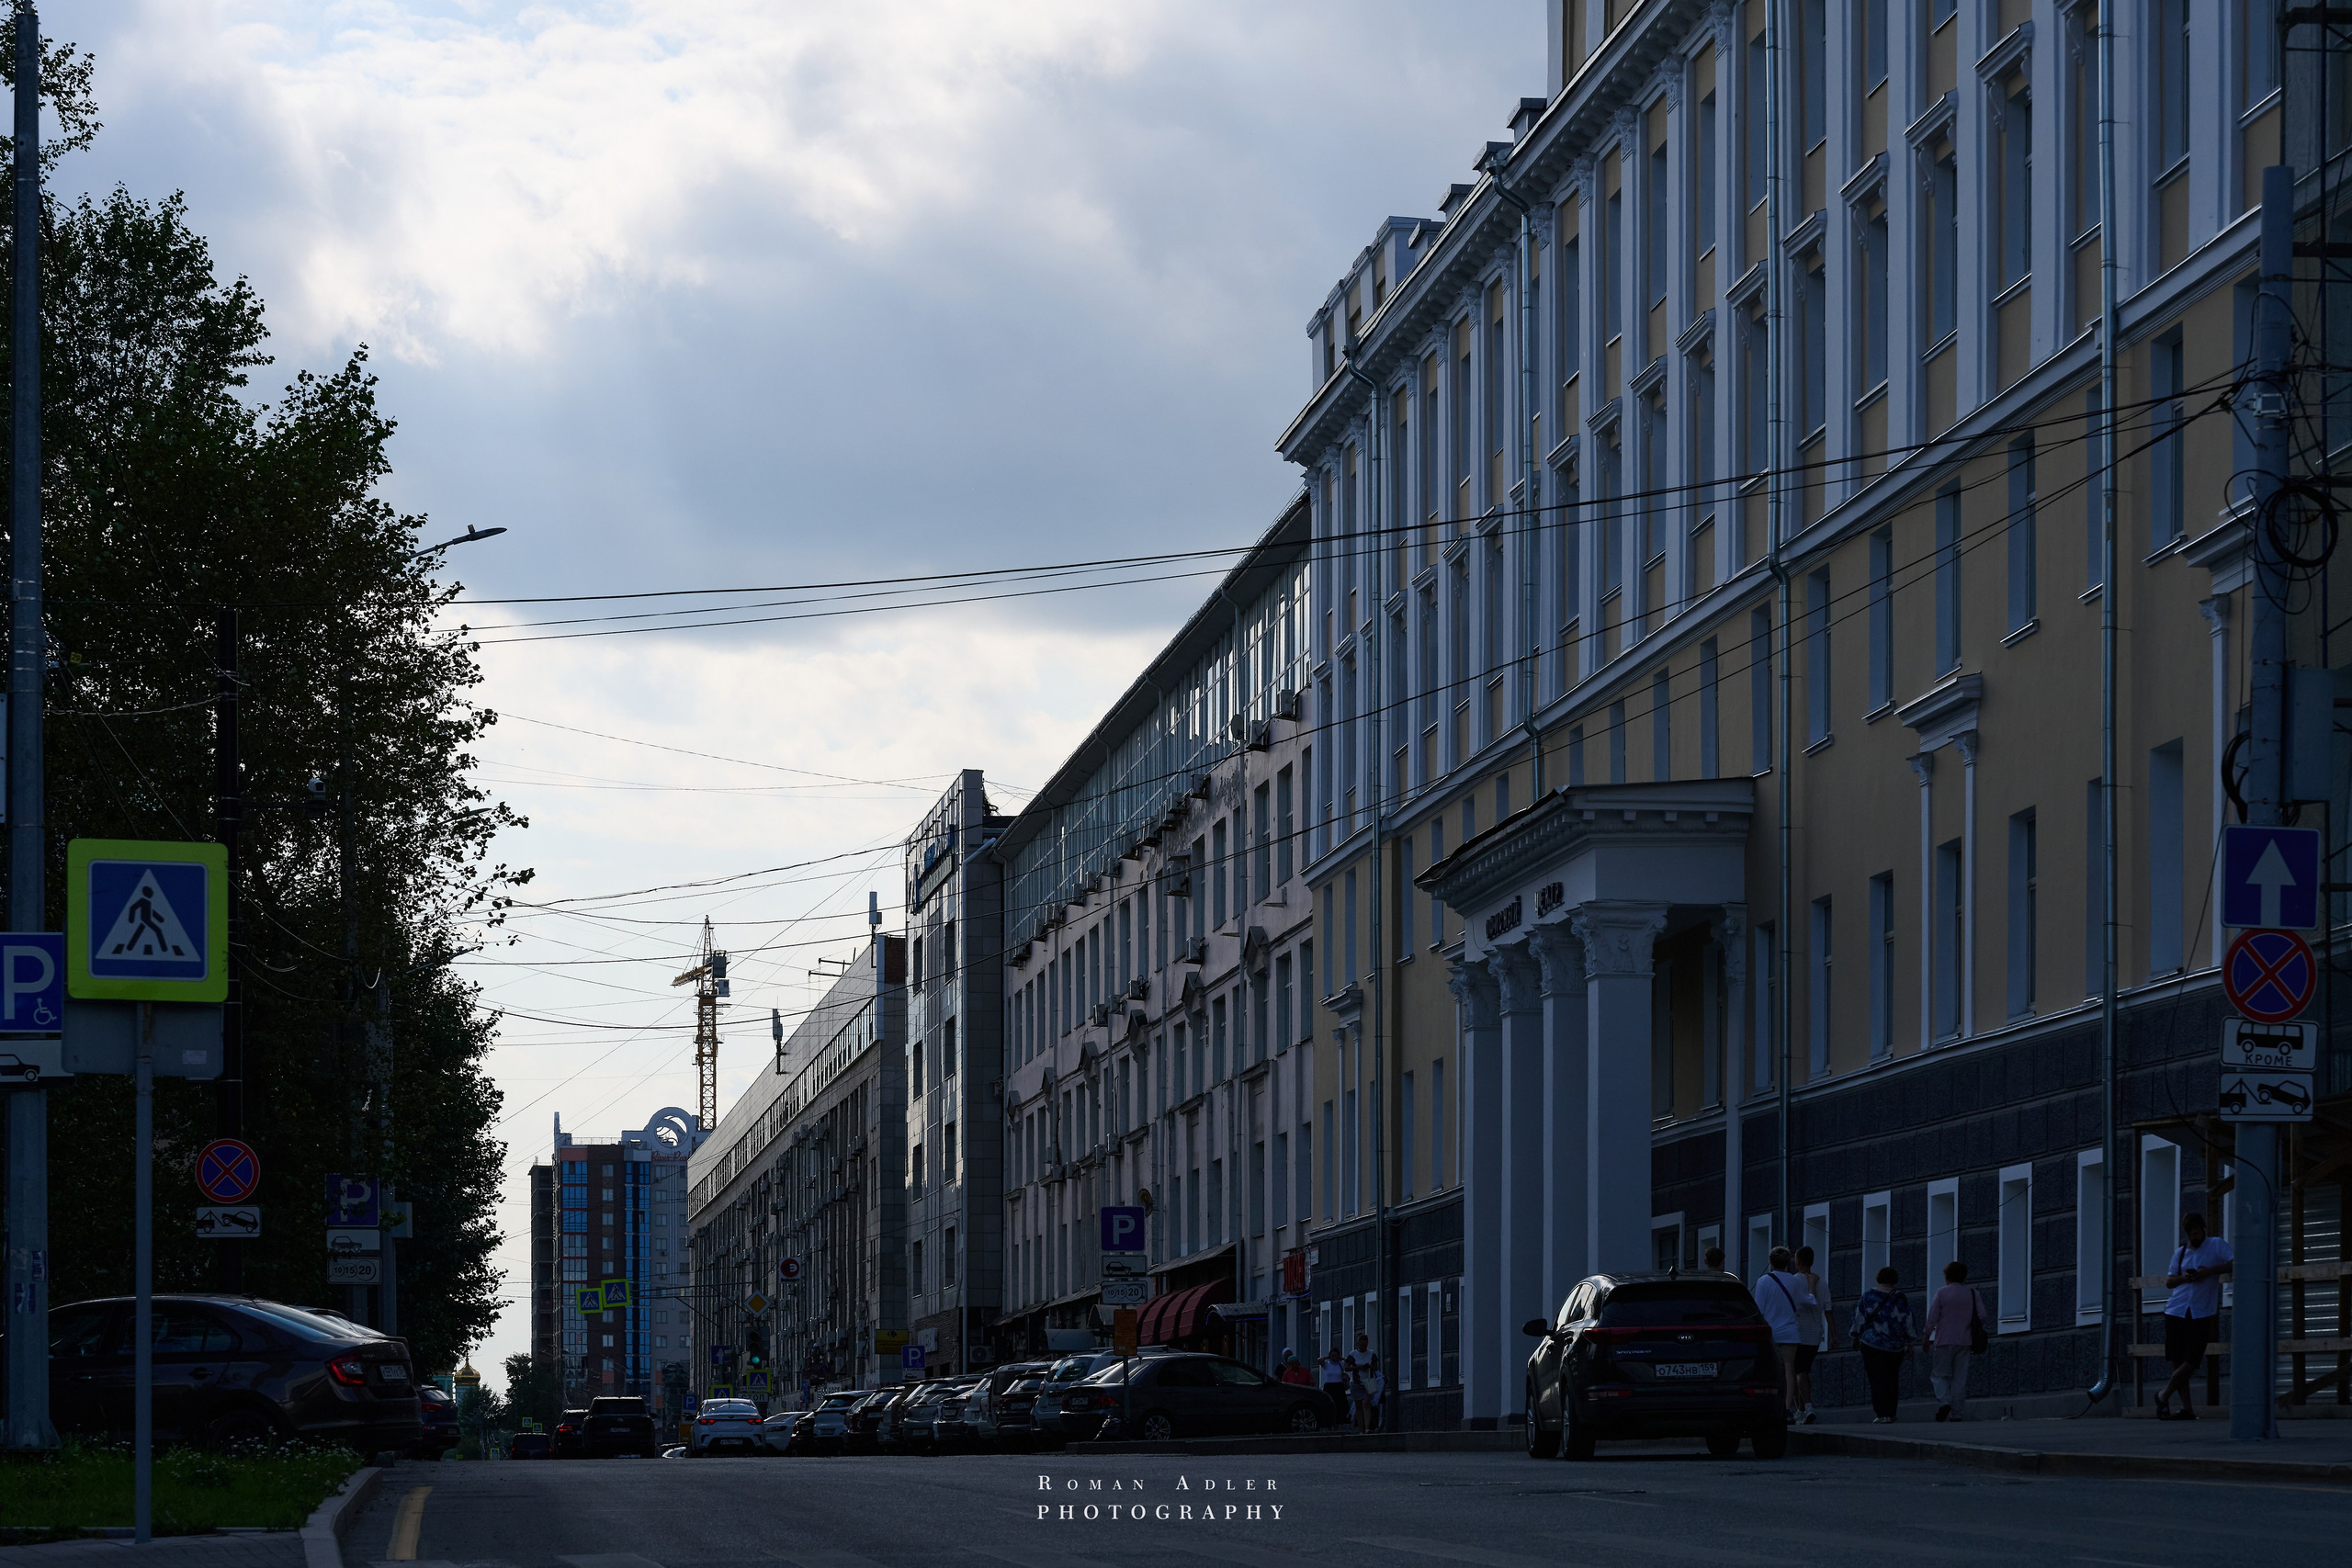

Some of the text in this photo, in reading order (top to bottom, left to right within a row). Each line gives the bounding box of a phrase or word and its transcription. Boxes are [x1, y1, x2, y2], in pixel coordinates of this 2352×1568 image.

[3, 945, 55, 1020] P
[2245, 1054, 2292, 1066] КРОМЕ
[651, 1150, 670, 1161] River
[340, 1179, 371, 1223] P
[1113, 1214, 1136, 1245] P
[345, 1266, 356, 1274] 15
[358, 1265, 371, 1275] 20
[1128, 1288, 1139, 1296] 20
[908, 1348, 922, 1366] P
[1700, 1363, 1714, 1371] 159
[685, 1395, 695, 1408] P
